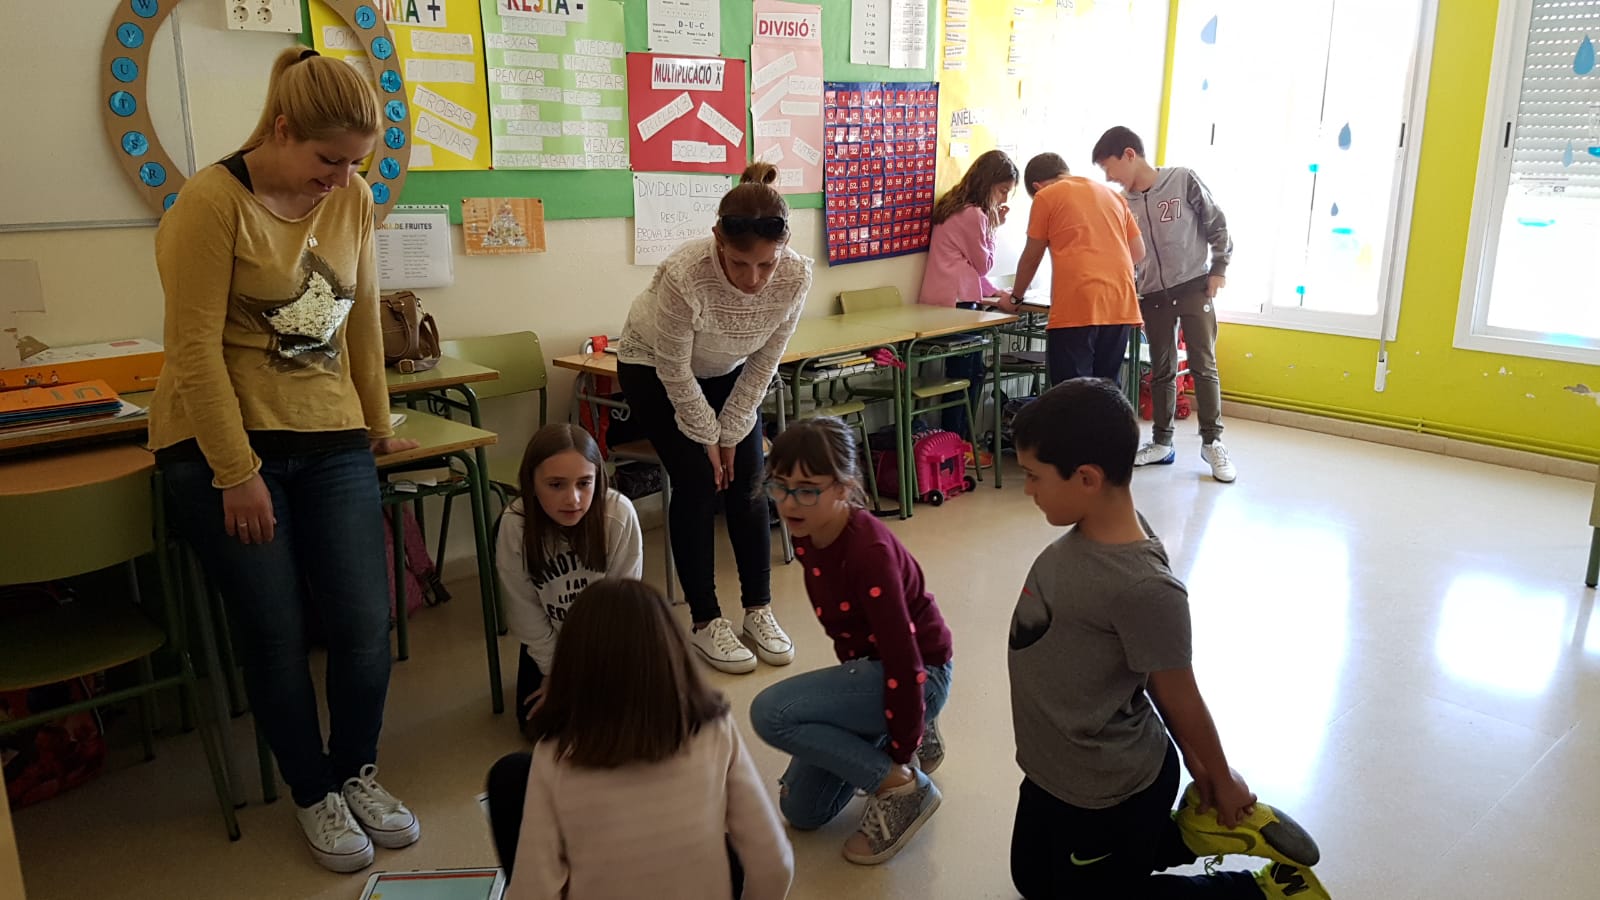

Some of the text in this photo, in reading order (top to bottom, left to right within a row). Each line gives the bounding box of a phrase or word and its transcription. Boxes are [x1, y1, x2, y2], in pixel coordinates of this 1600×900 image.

[362, 13, 370, 22] D
[759, 19, 808, 36] DIVISIÓ
[378, 44, 386, 52] E
[120, 64, 129, 74] U
[119, 98, 128, 108] T
[418, 88, 472, 126] TROBAR
[392, 106, 400, 116] G
[394, 134, 400, 143] H
[416, 117, 472, 154] DONAR
[131, 139, 139, 149] S
[585, 138, 624, 153] MENYS
[149, 169, 158, 178] R
[638, 178, 687, 197] DIVIDEND
[696, 183, 730, 193] DIVISOR
[1158, 198, 1182, 222] 27
[566, 578, 588, 591] I AM
